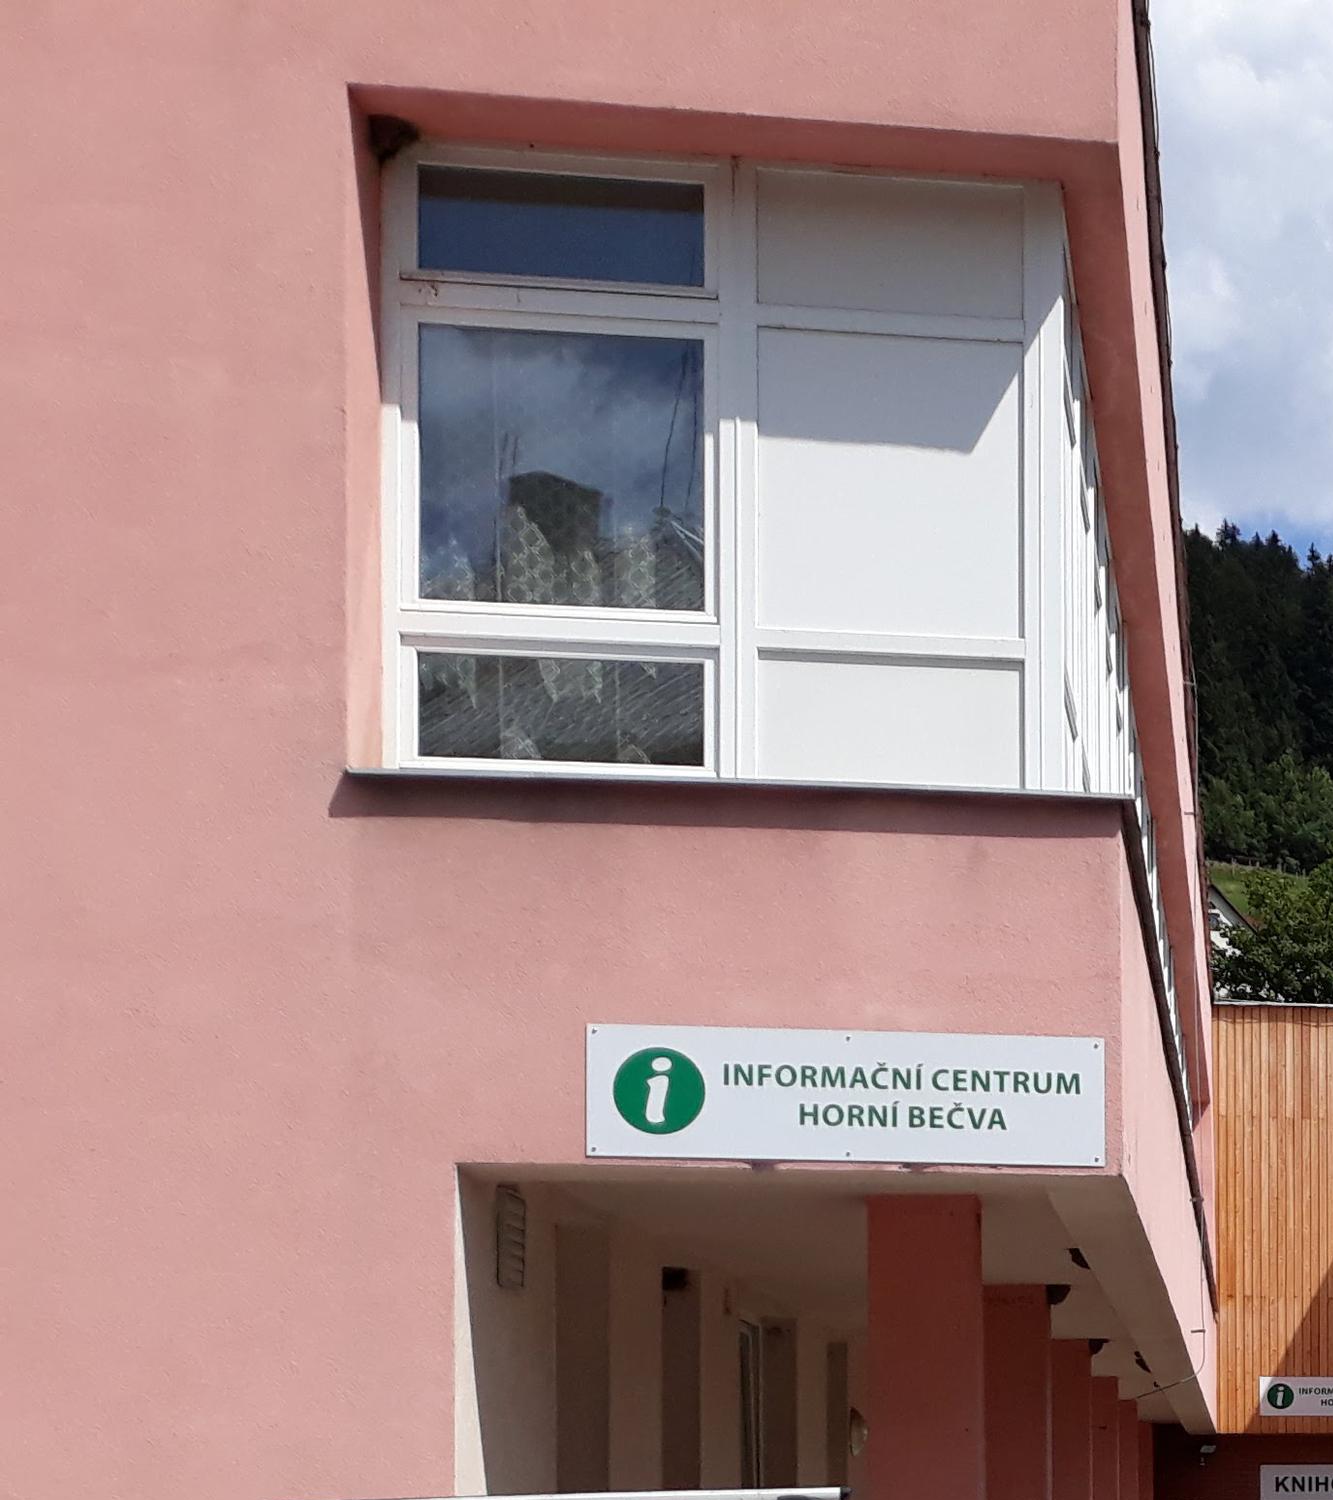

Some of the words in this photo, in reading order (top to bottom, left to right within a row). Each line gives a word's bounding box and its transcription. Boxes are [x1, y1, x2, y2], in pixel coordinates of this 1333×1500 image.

[722, 1060, 923, 1091] INFORMAČNÍ
[931, 1068, 1082, 1095] CENTRUM
[798, 1100, 900, 1129] HORNÍ
[908, 1102, 1008, 1131] BEČVA
